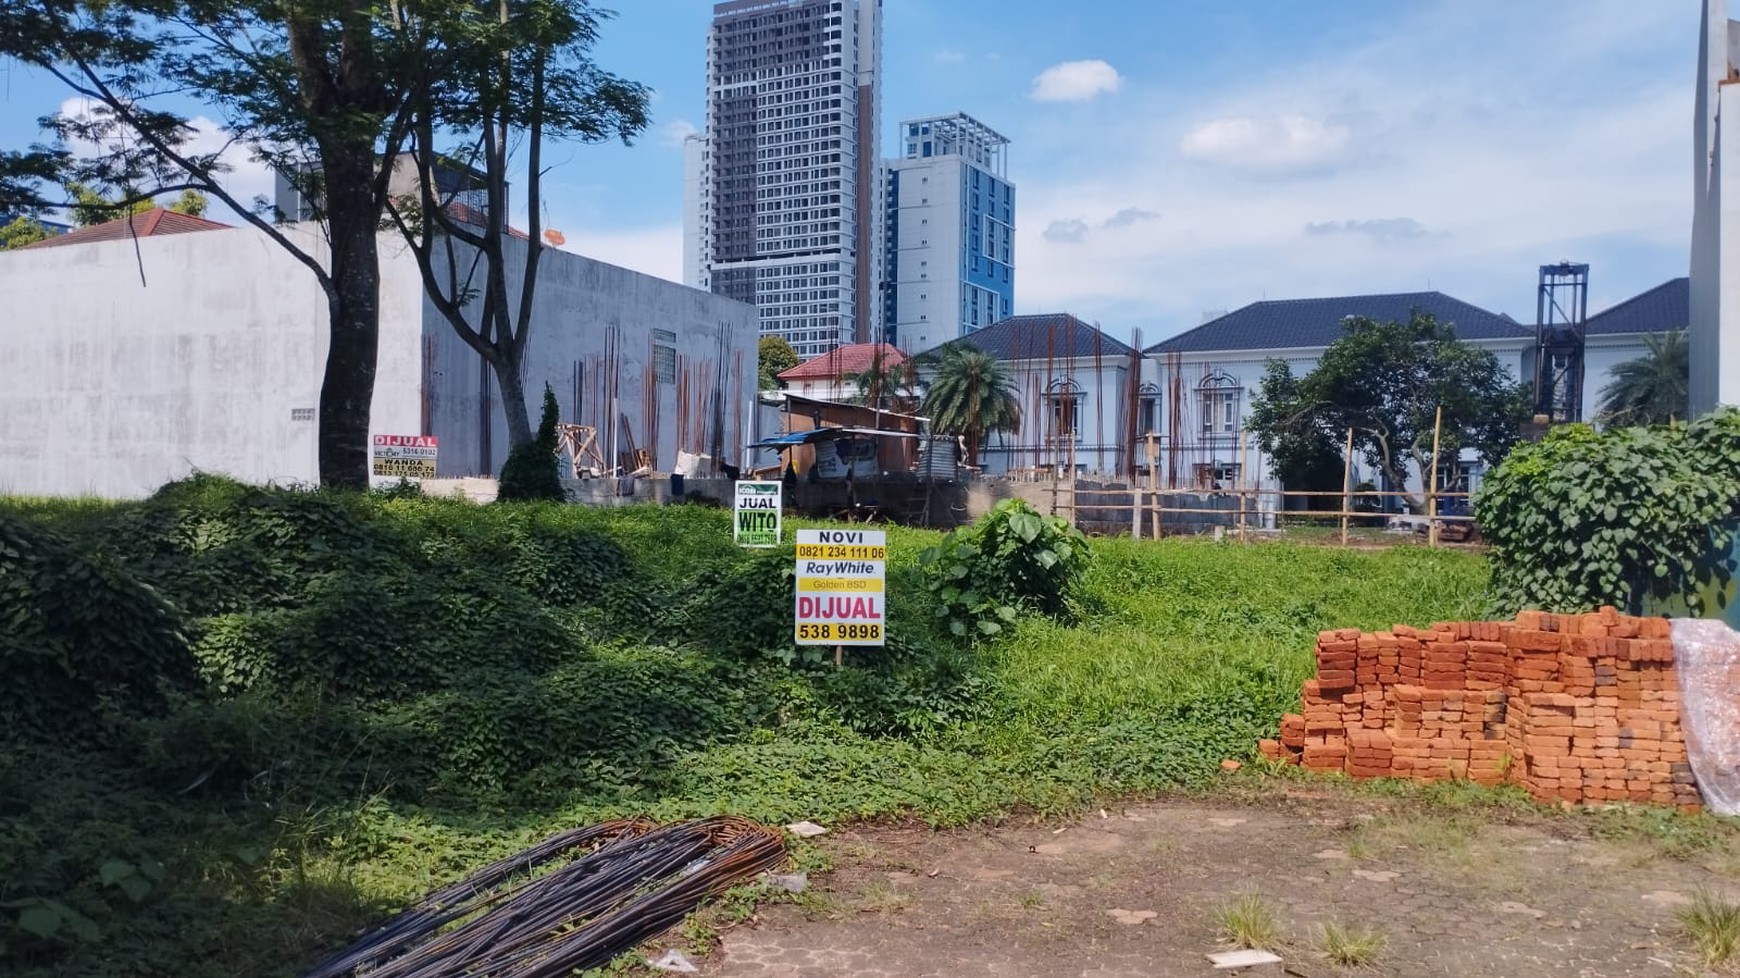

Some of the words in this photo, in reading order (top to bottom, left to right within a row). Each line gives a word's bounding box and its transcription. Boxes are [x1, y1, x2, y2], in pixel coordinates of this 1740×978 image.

[374, 435, 437, 446] DIJUAL
[739, 498, 777, 509] JUAL
[738, 512, 777, 532] WITO
[819, 531, 863, 543] NOVI
[799, 546, 824, 557] 0821
[828, 546, 847, 557] 234
[850, 547, 868, 558] 111
[871, 547, 884, 559] 06
[813, 580, 844, 589] Golden
[847, 580, 867, 589] BSD
[799, 597, 881, 619] DIJUAL
[800, 624, 830, 639] 538
[837, 624, 880, 639] 9898
